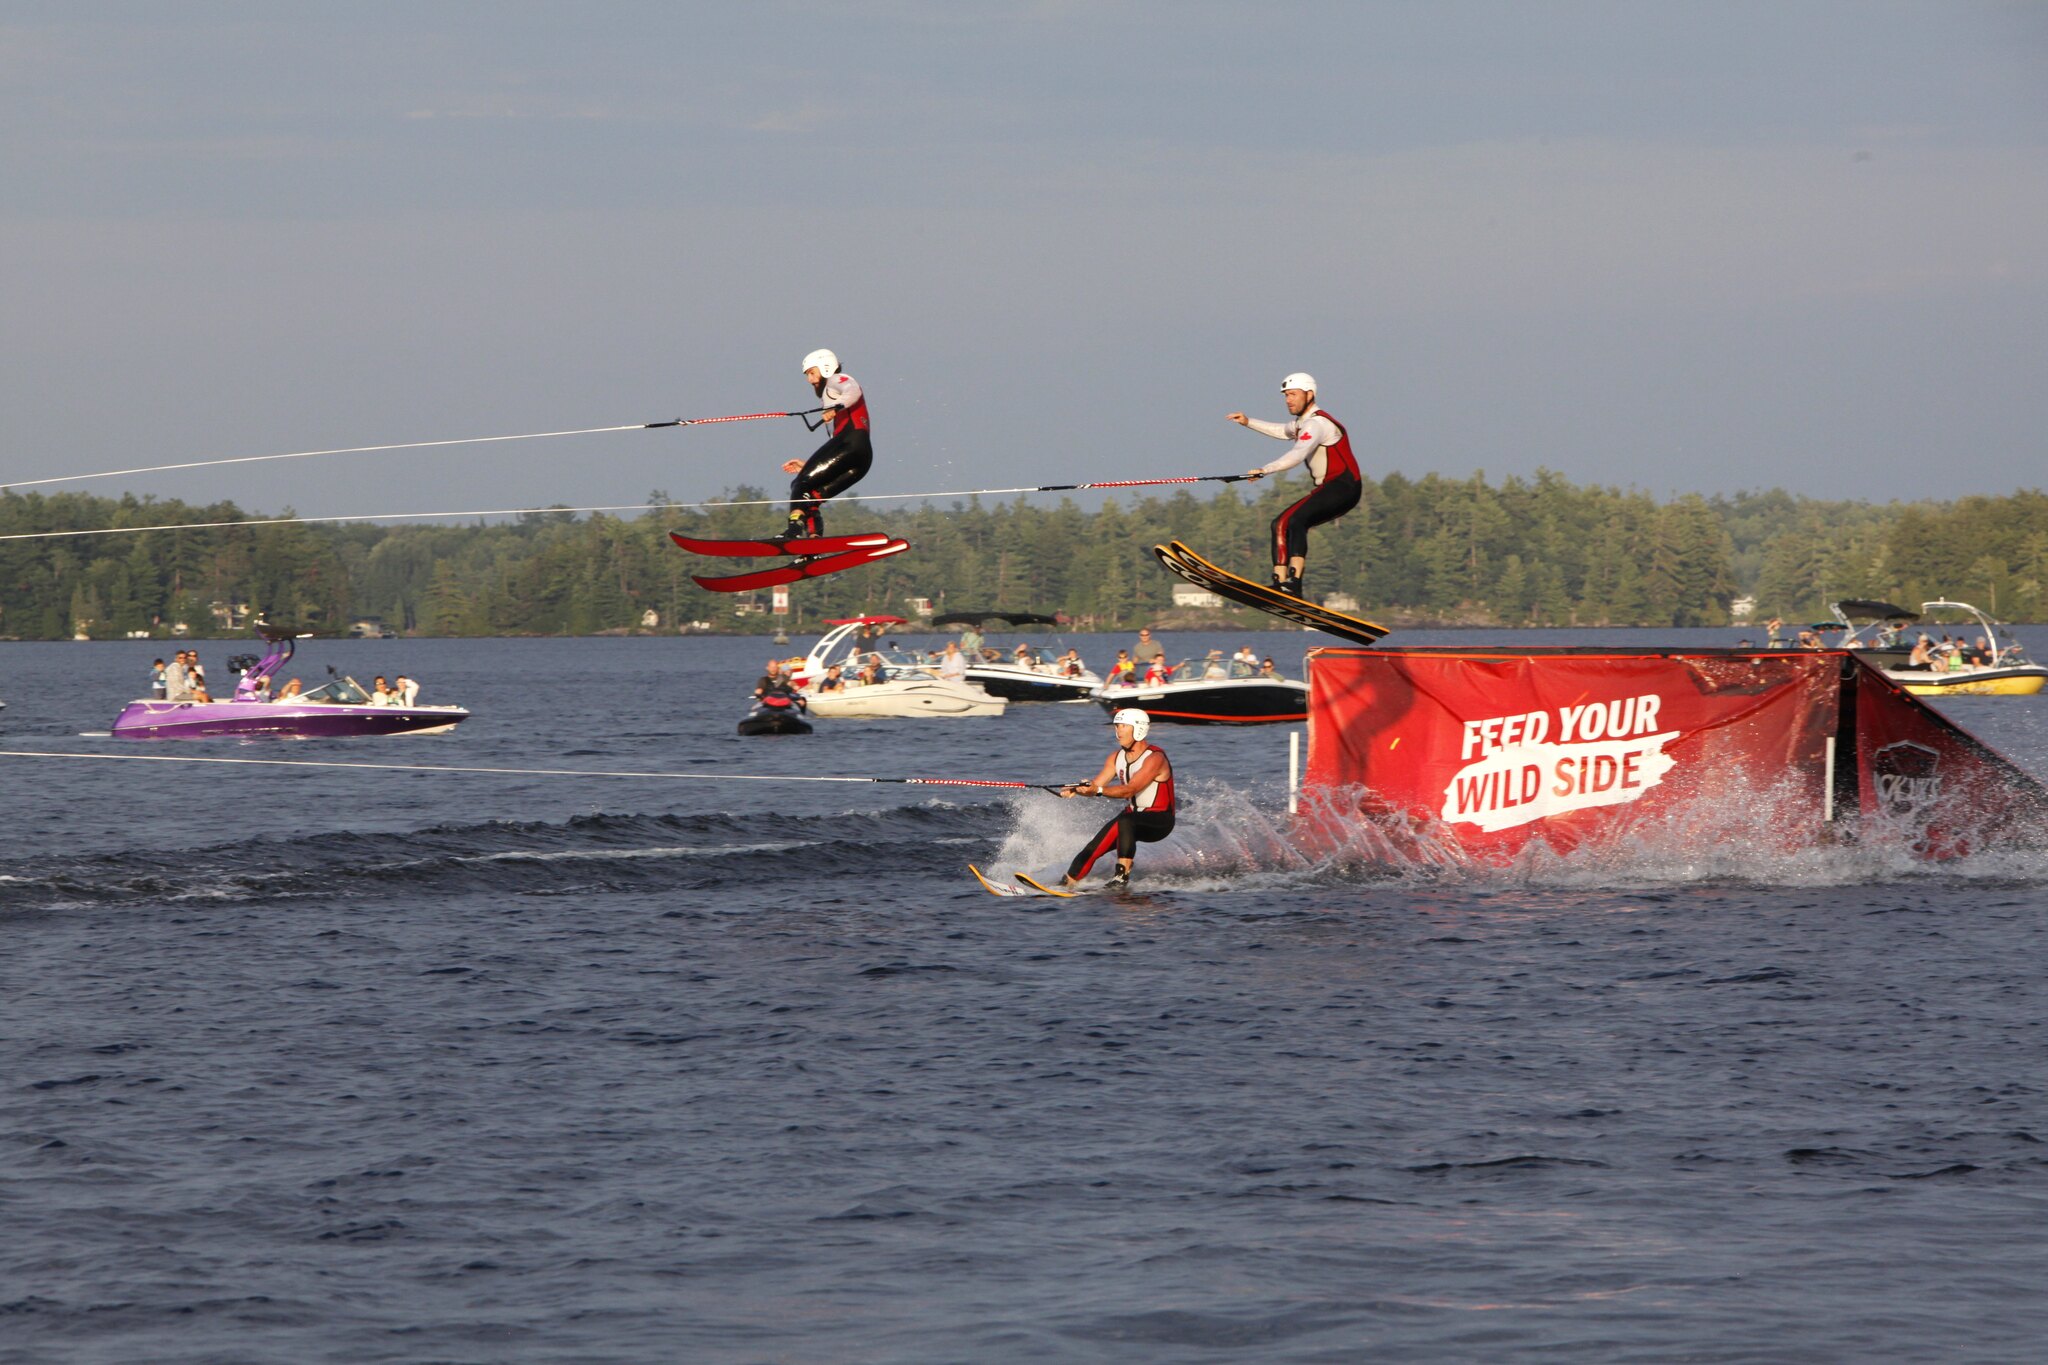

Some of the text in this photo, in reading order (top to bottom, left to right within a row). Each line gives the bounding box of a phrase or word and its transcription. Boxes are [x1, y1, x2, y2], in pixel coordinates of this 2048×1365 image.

[1461, 694, 1661, 760] FEED YOUR
[1457, 750, 1643, 815] WILD SIDE
